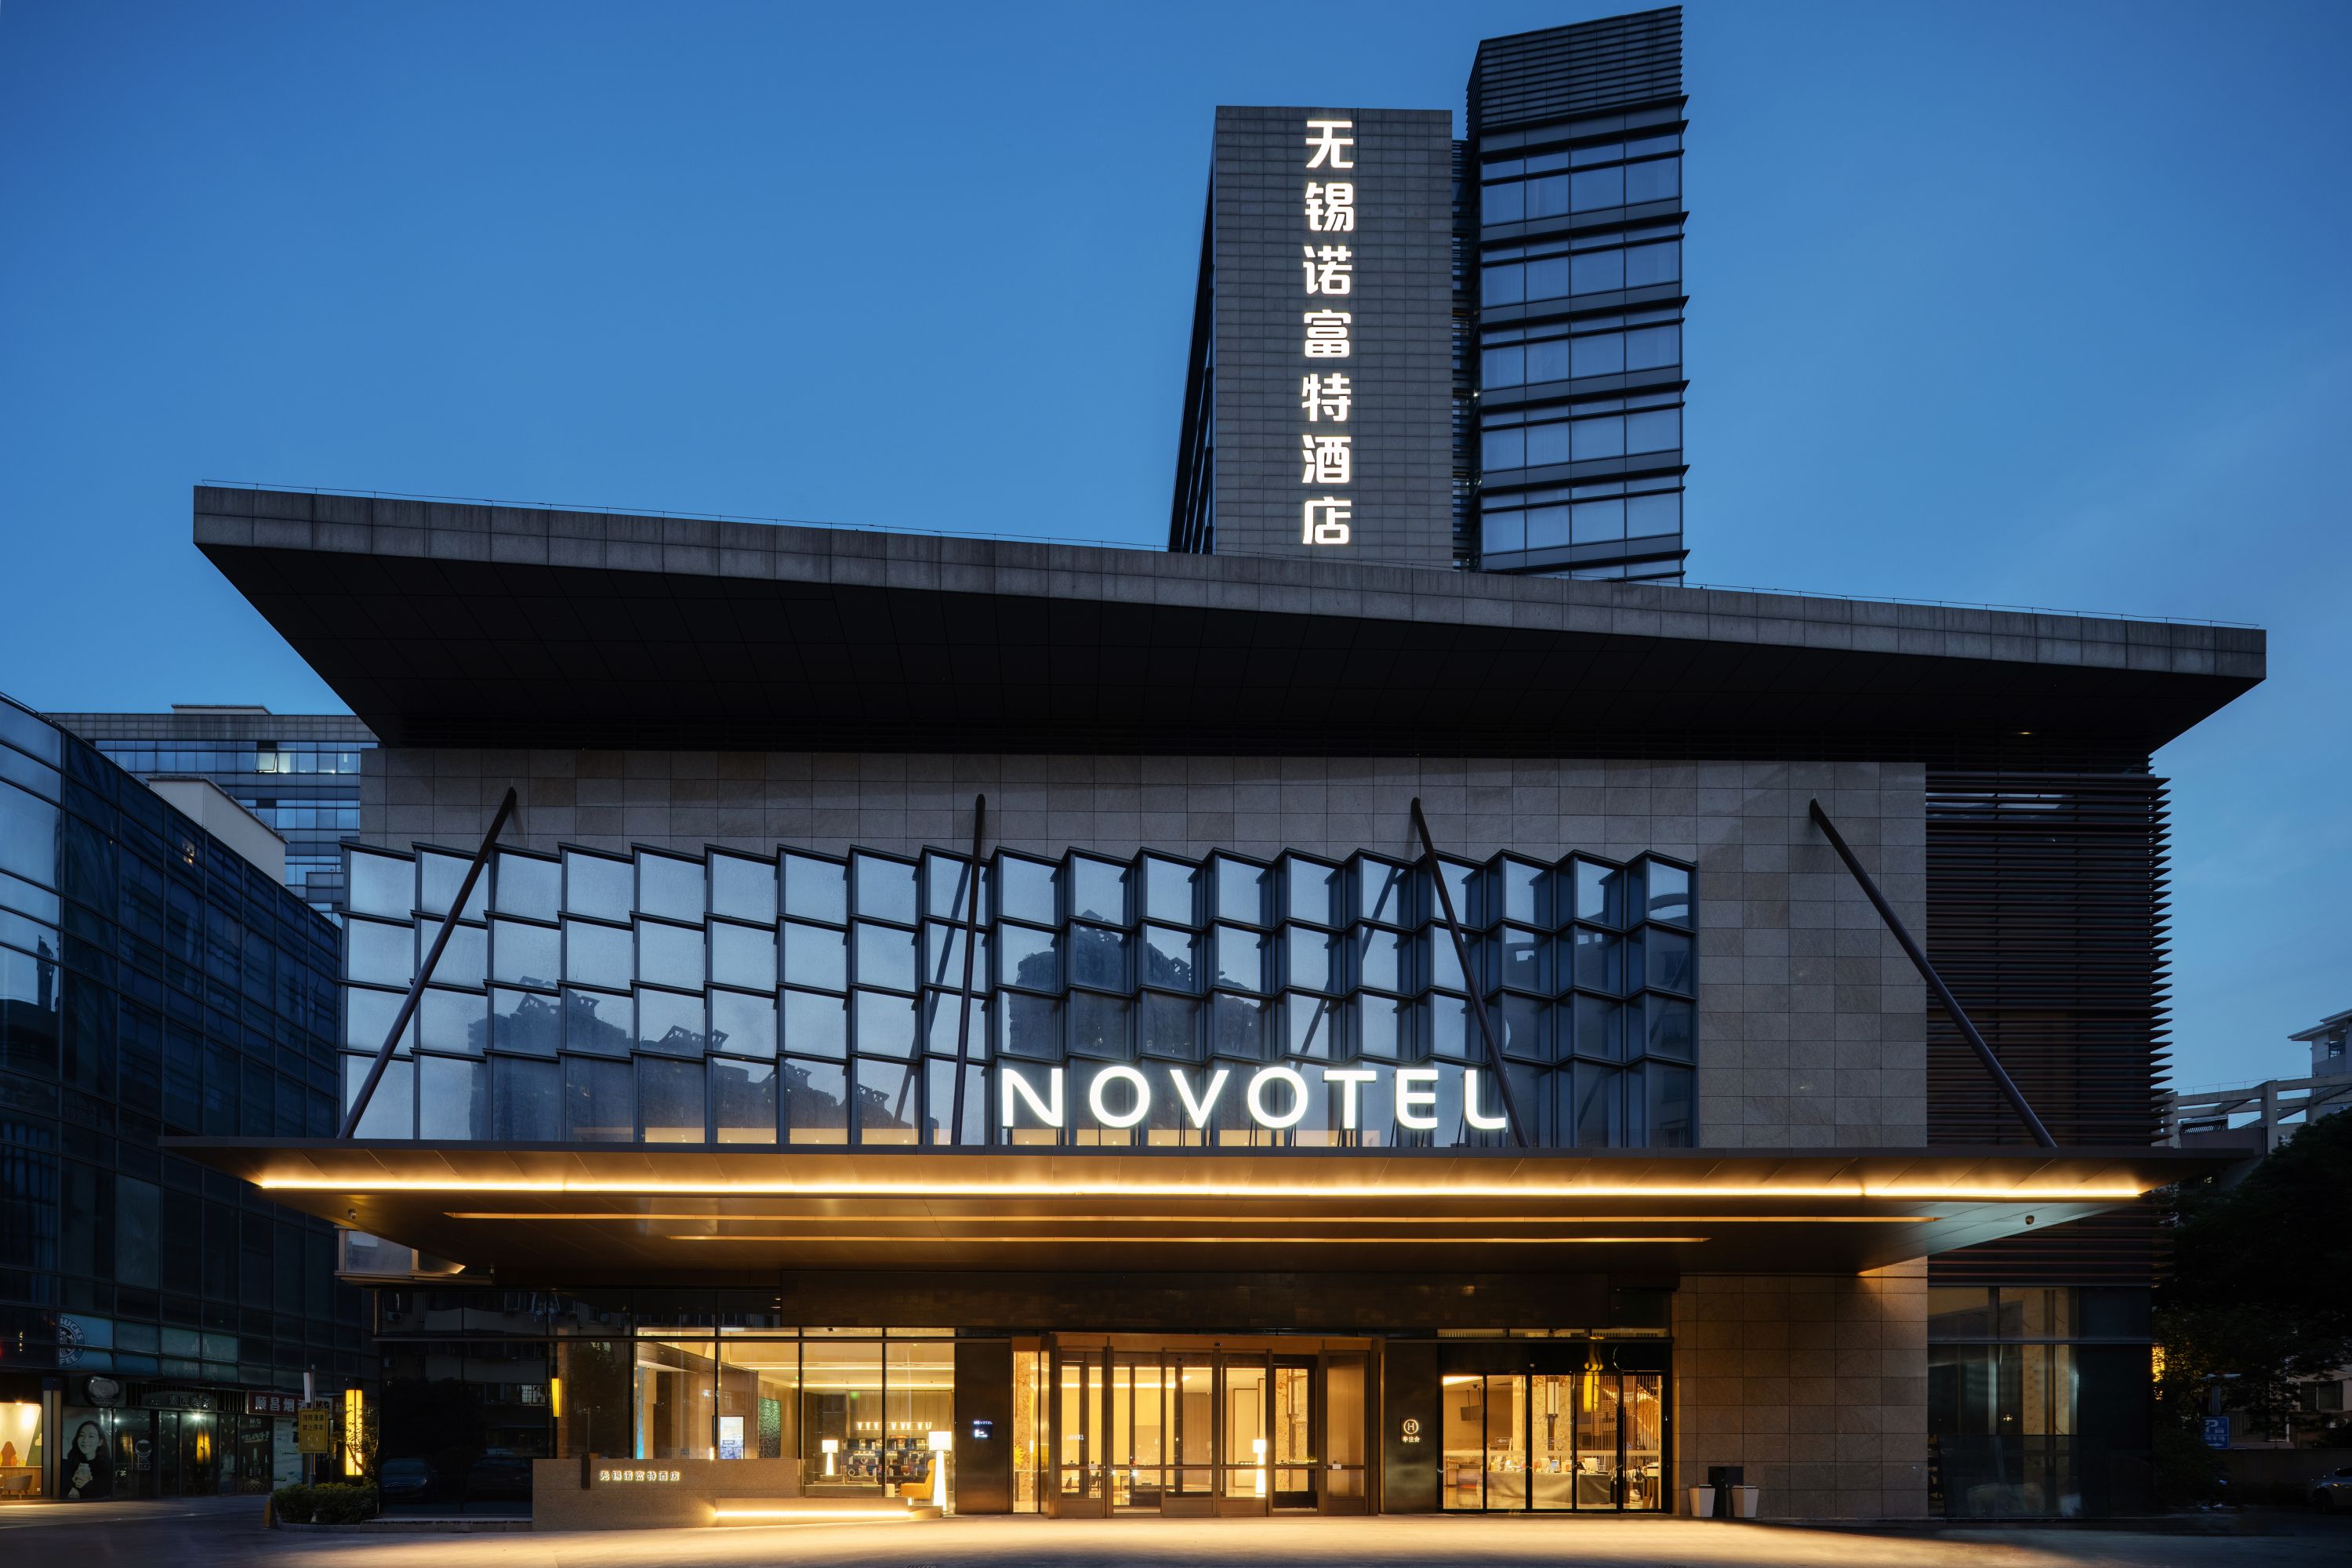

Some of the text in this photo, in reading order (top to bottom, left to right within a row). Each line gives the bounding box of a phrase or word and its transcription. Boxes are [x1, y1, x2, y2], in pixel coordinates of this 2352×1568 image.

[1301, 119, 1355, 546] 无锡诺富特酒店
[1001, 1066, 1507, 1130] NOVOTEL
[600, 1471, 680, 1481] 无锡诺富特酒店
